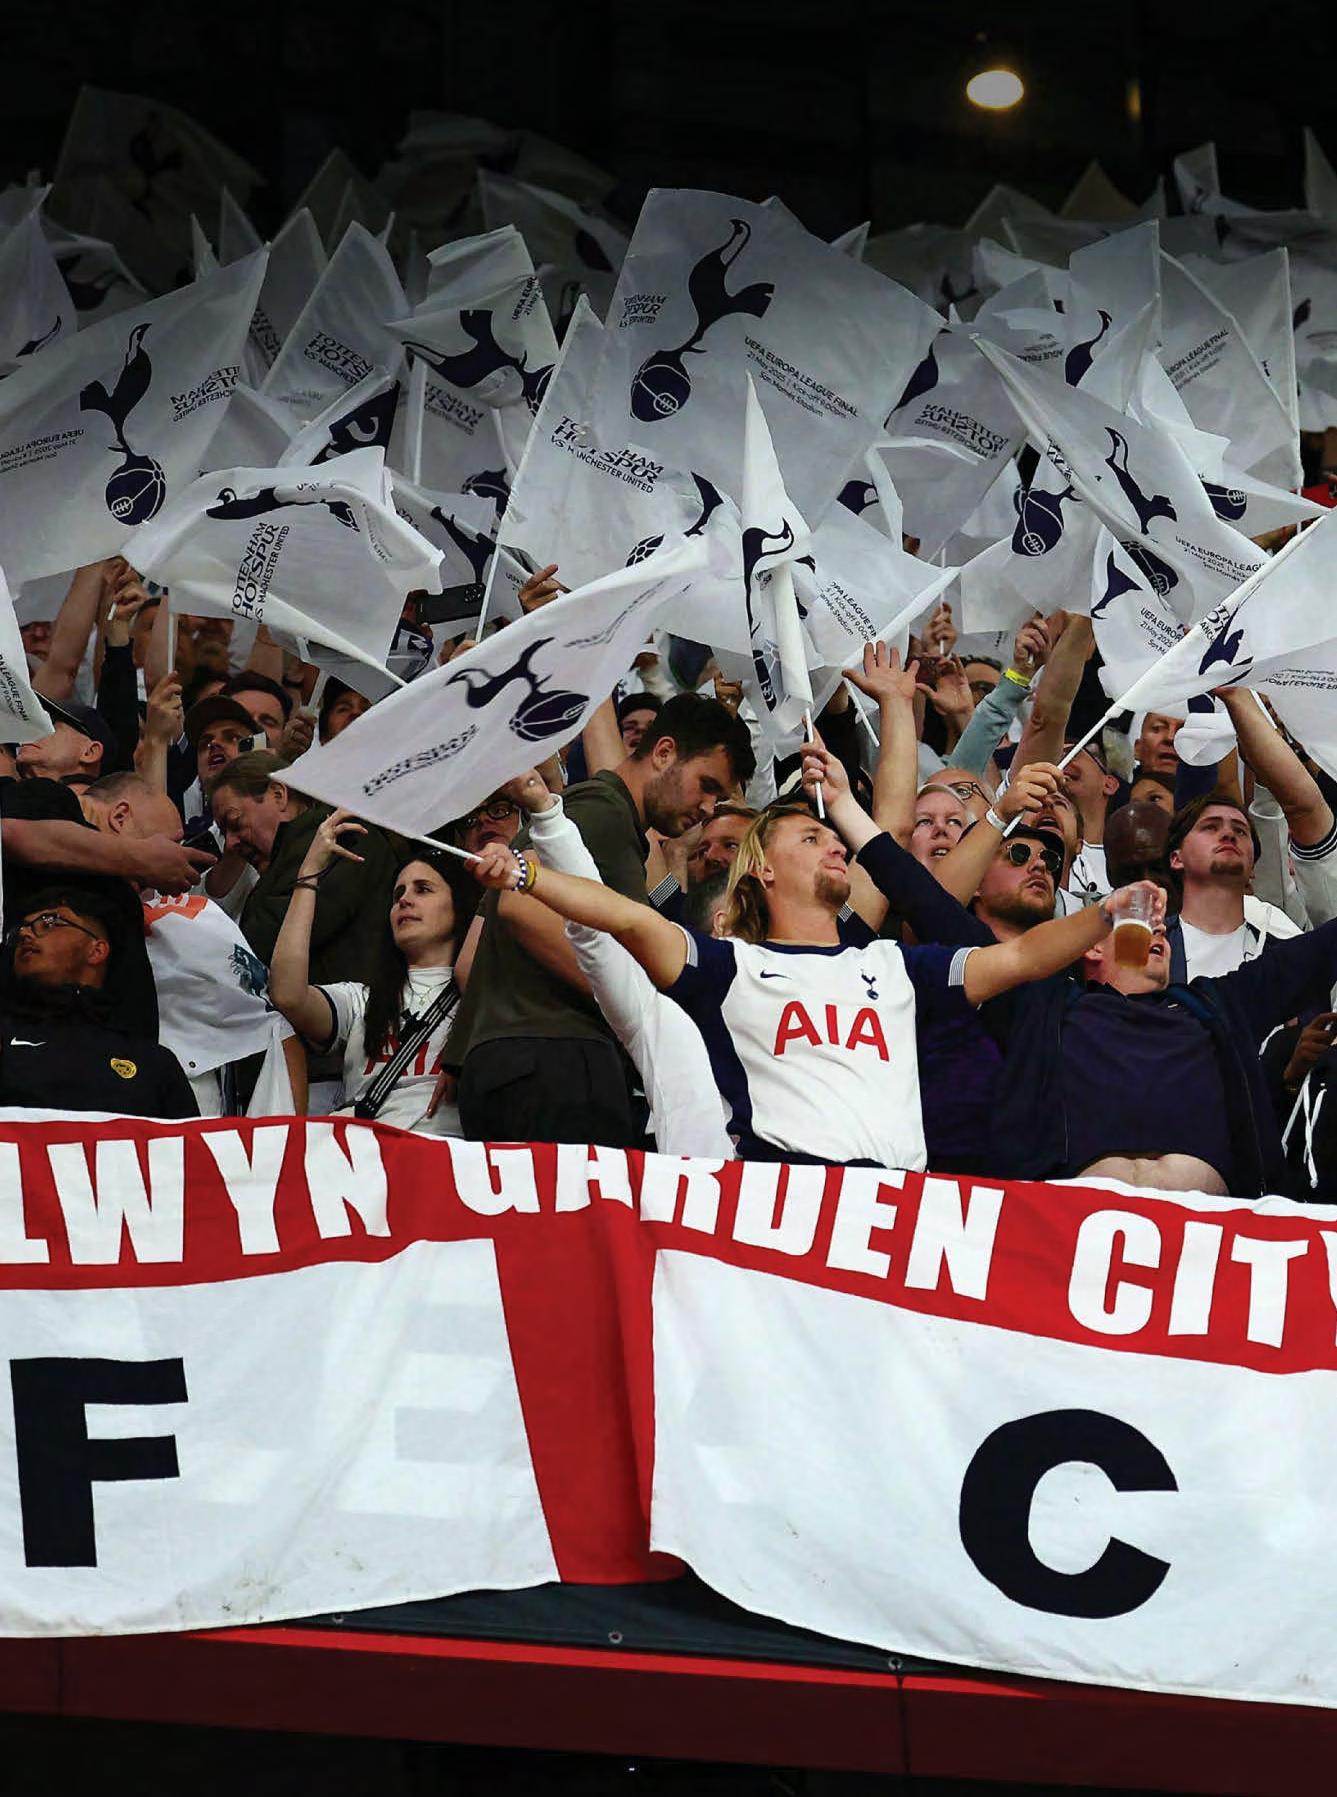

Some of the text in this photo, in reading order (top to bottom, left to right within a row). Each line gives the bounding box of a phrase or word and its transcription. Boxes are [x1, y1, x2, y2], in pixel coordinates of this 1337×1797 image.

[744, 335, 859, 418] UEFA EUROPA LEAGUE FINAL
[551, 435, 566, 448] VS
[622, 473, 654, 494] UNITED
[272, 525, 290, 552] UNITED
[1175, 534, 1198, 553] UEFA
[1196, 546, 1234, 567] EUROPA
[242, 524, 280, 620] HOTSPUR
[1207, 557, 1226, 569] 2025
[842, 593, 871, 625] LEAGUE
[1140, 607, 1157, 625] UEFA
[1156, 632, 1173, 648] 2025
[774, 1001, 890, 1062] AIA
[0, 1121, 392, 1266] LWYN
[448, 1139, 1005, 1301] GARDEN
[9, 1356, 1180, 1620] F C
